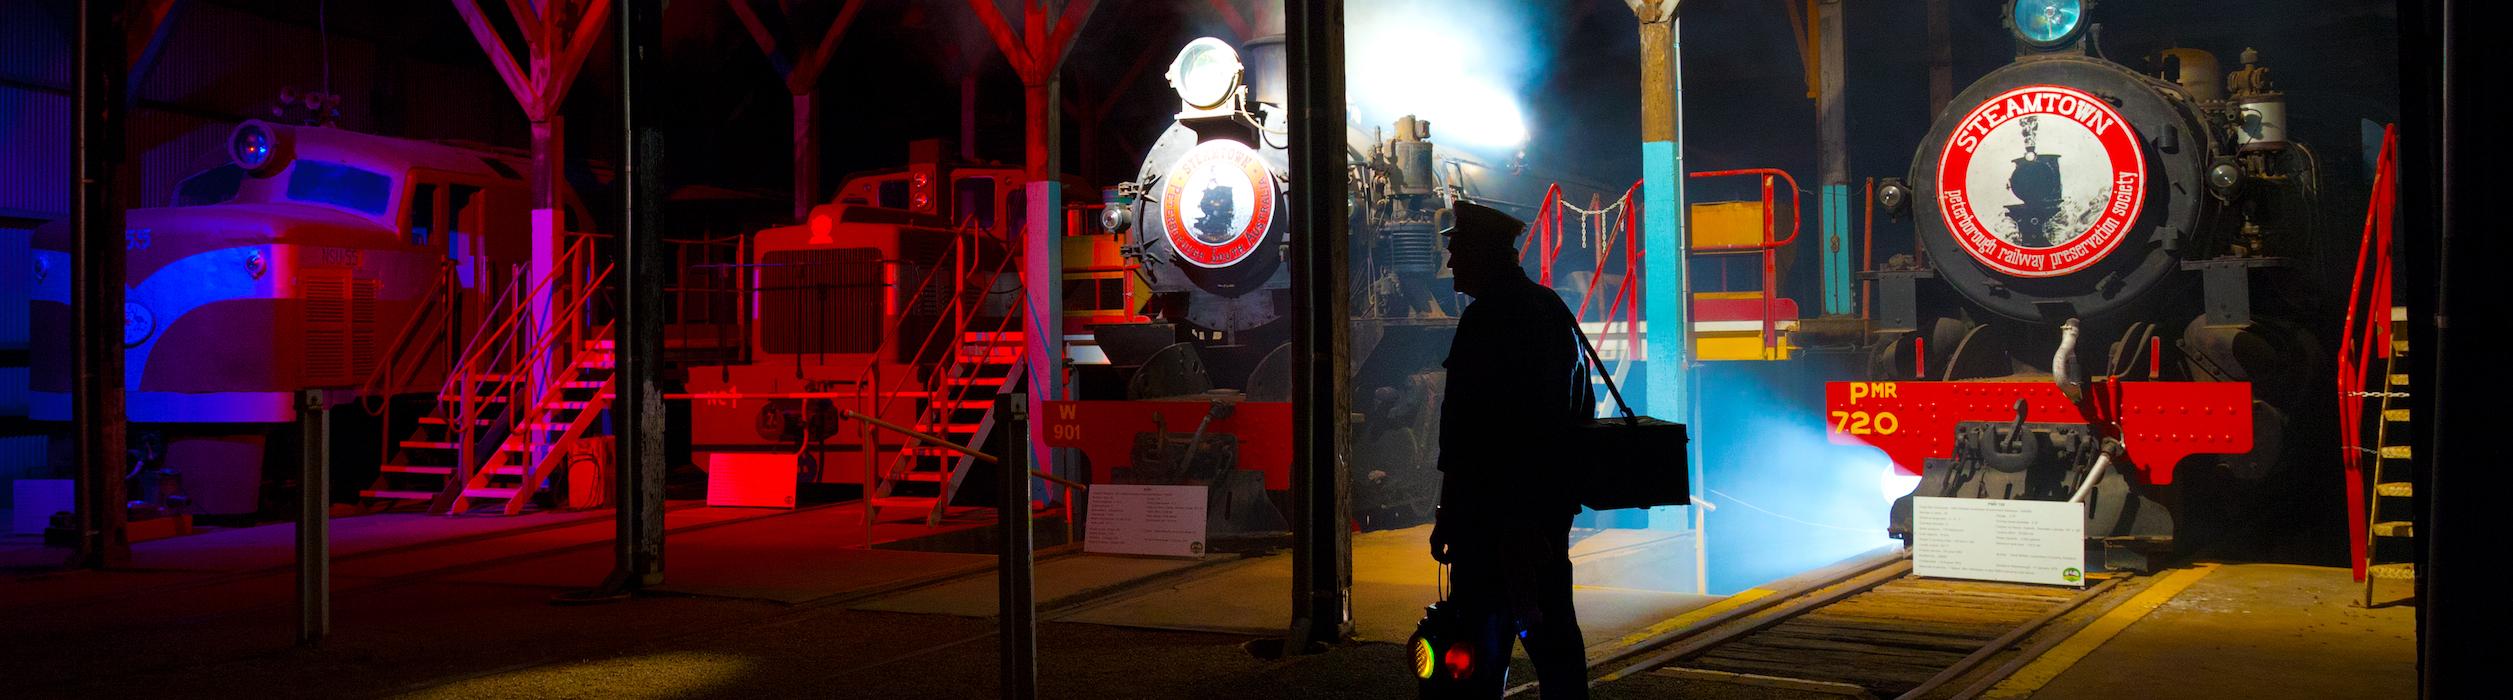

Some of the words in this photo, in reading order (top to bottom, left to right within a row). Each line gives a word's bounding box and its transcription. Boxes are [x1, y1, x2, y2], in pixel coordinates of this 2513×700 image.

[1957, 92, 2114, 154] STEAMTOWN
[1211, 245, 1244, 262] SOUTH
[1245, 176, 1269, 246] AUSTRALIA
[1944, 189, 1997, 255] peterborough
[1997, 246, 2045, 270] railway
[2050, 217, 2120, 269] preservation
[2112, 171, 2138, 216] society
[1850, 382, 1897, 405] PMR
[1059, 403, 1076, 420] W
[1831, 410, 1899, 435] 720
[1054, 424, 1080, 440] 901
